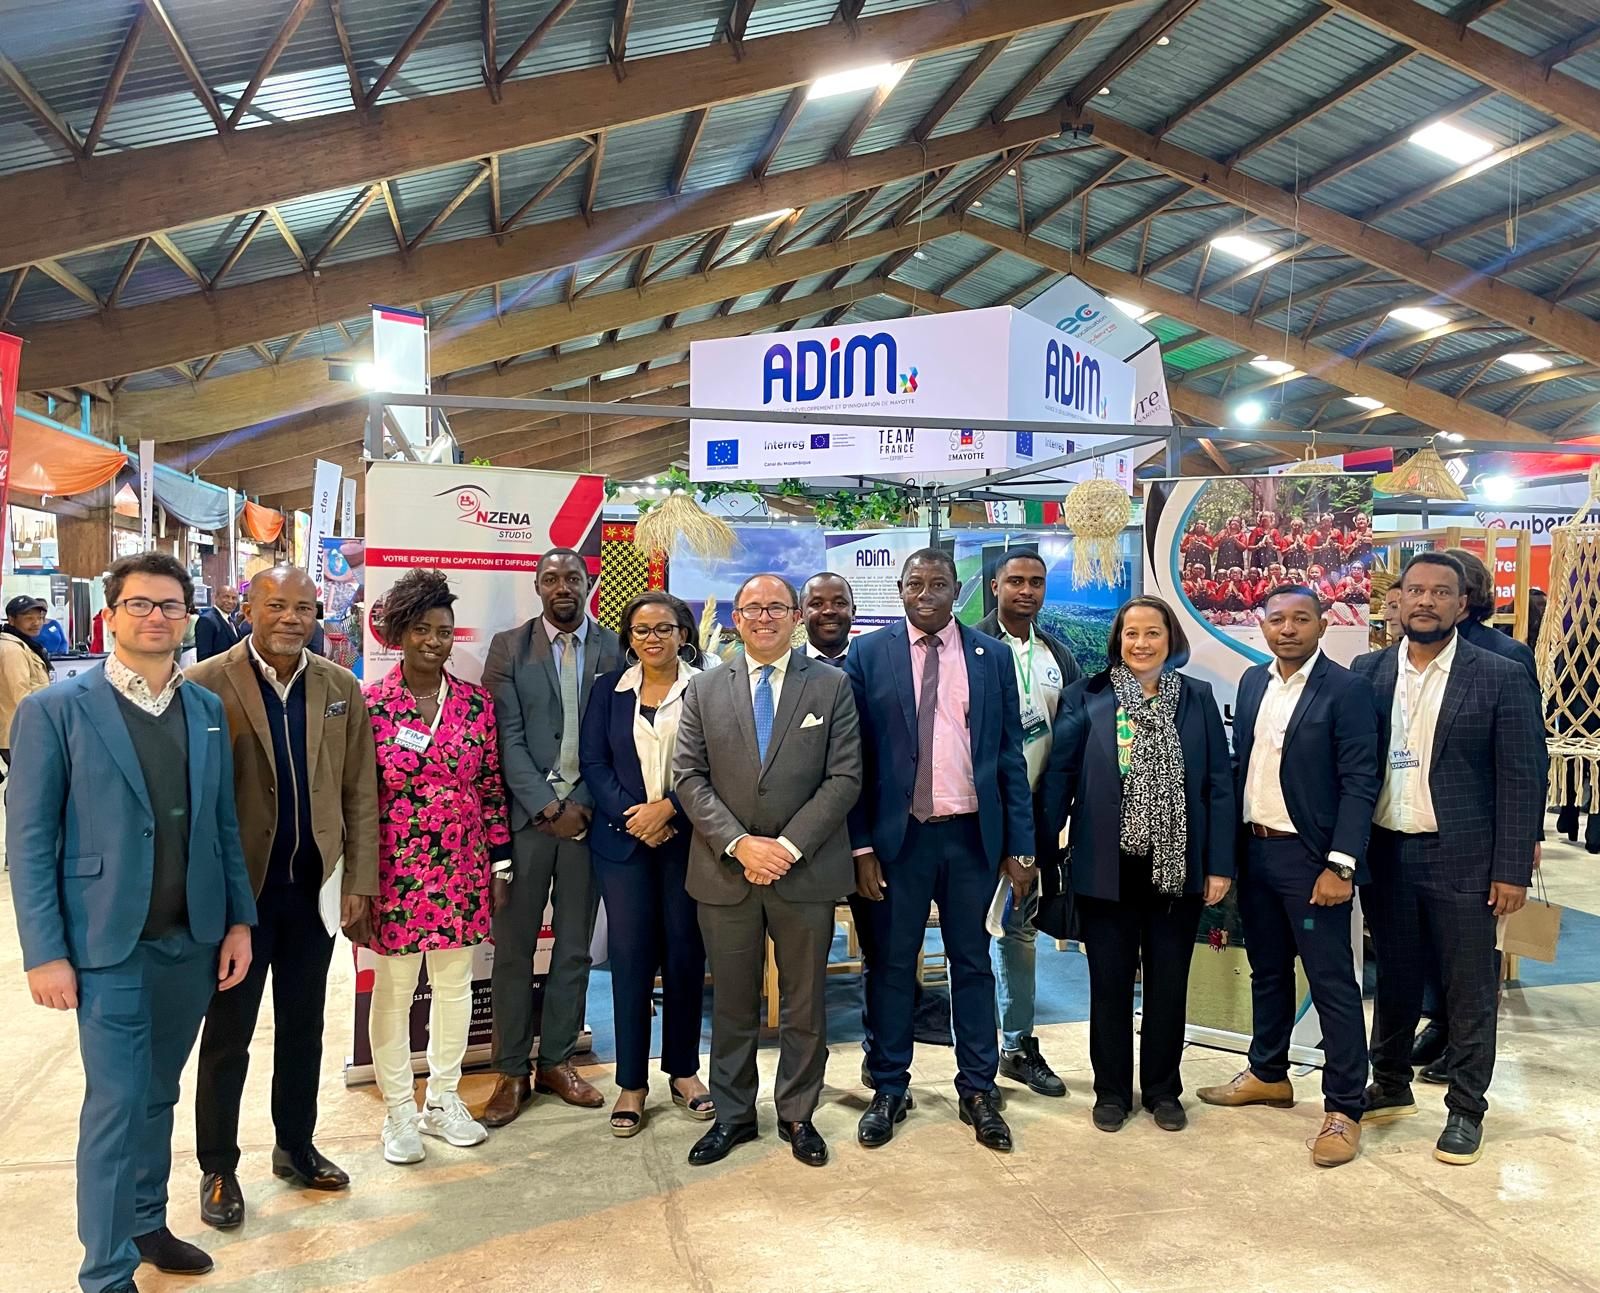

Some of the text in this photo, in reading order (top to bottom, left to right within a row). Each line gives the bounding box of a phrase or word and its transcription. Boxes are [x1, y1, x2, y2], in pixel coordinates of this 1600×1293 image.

[879, 428, 914, 444] TEAM
[764, 440, 805, 451] Interreg
[880, 444, 914, 455] FRANCE
[952, 452, 985, 461] MAYOTTE
[321, 491, 329, 514] cfao
[505, 559, 538, 567] DIFFUSIO
[405, 729, 425, 742] FIM
[1393, 750, 1411, 758] FIM
